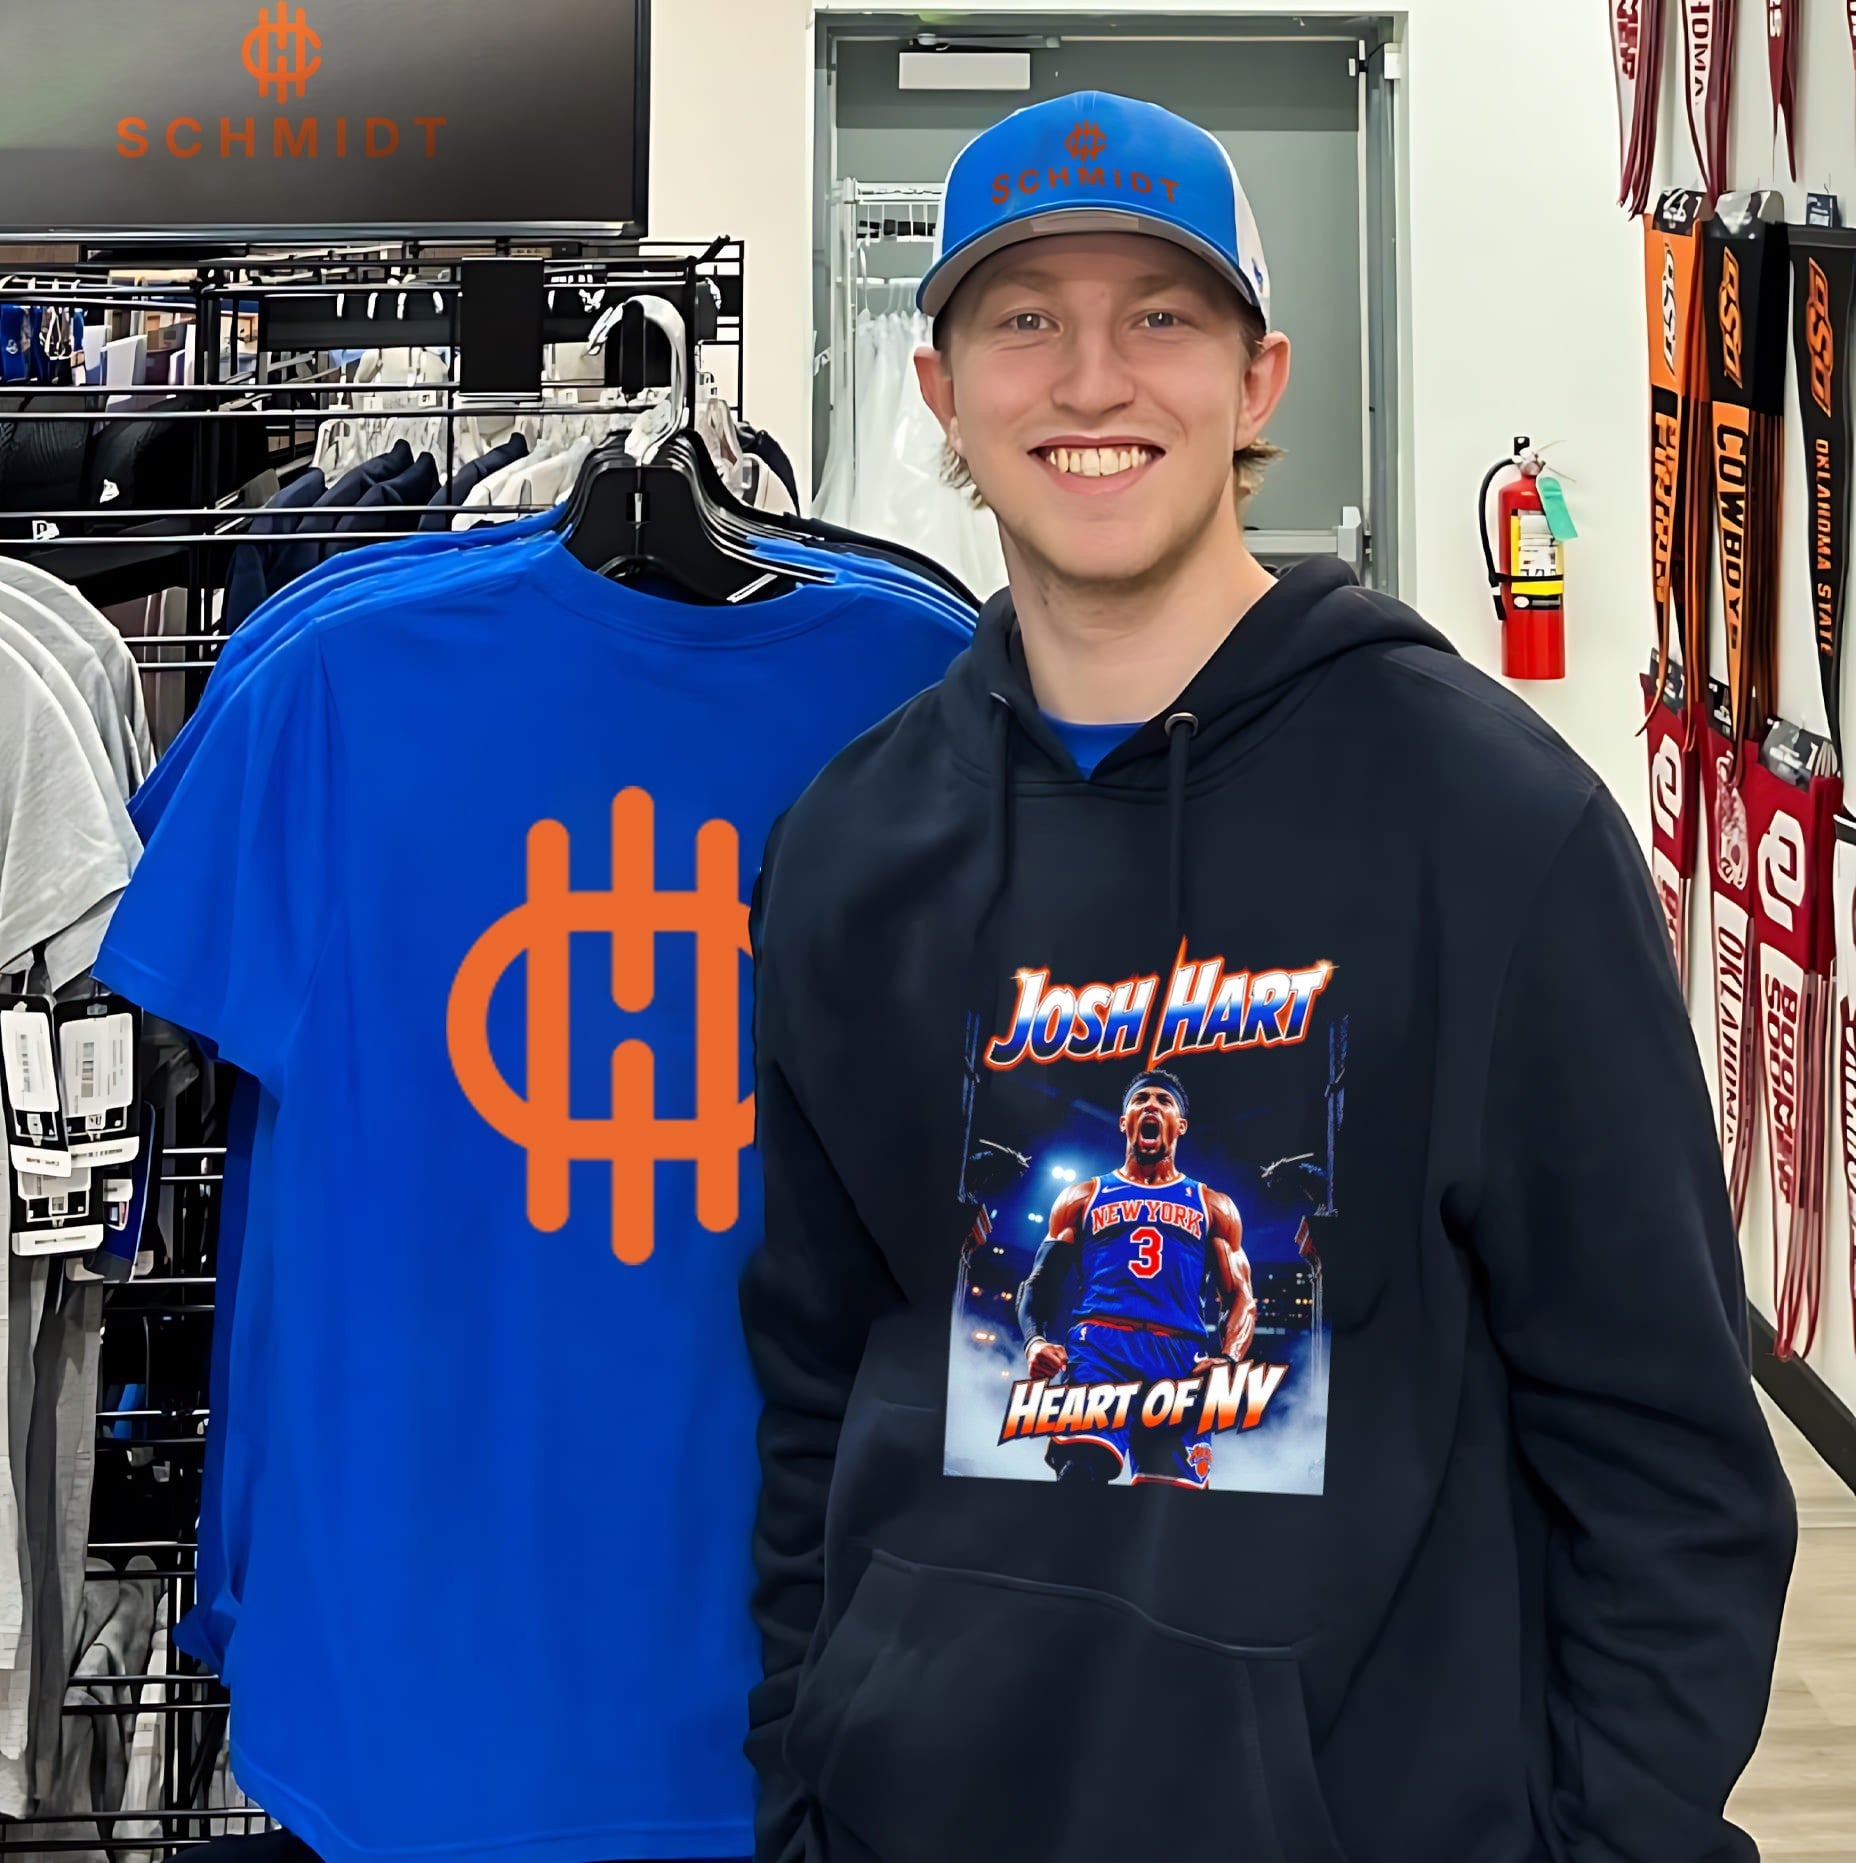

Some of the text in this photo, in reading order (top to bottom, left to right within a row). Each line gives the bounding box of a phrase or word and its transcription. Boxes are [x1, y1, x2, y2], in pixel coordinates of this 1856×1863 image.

[115, 115, 448, 159] SCHMIDT
[991, 166, 1180, 205] SCHMIDT
[1815, 438, 1832, 570] OKLAHOMA
[986, 936, 1335, 1070] JOSH HART
[1717, 925, 1746, 1145] OKLAHOMA
[1091, 1199, 1204, 1240] NEW YORK
[1128, 1226, 1163, 1279] 3
[998, 1359, 1292, 1446] HEART OF NY
